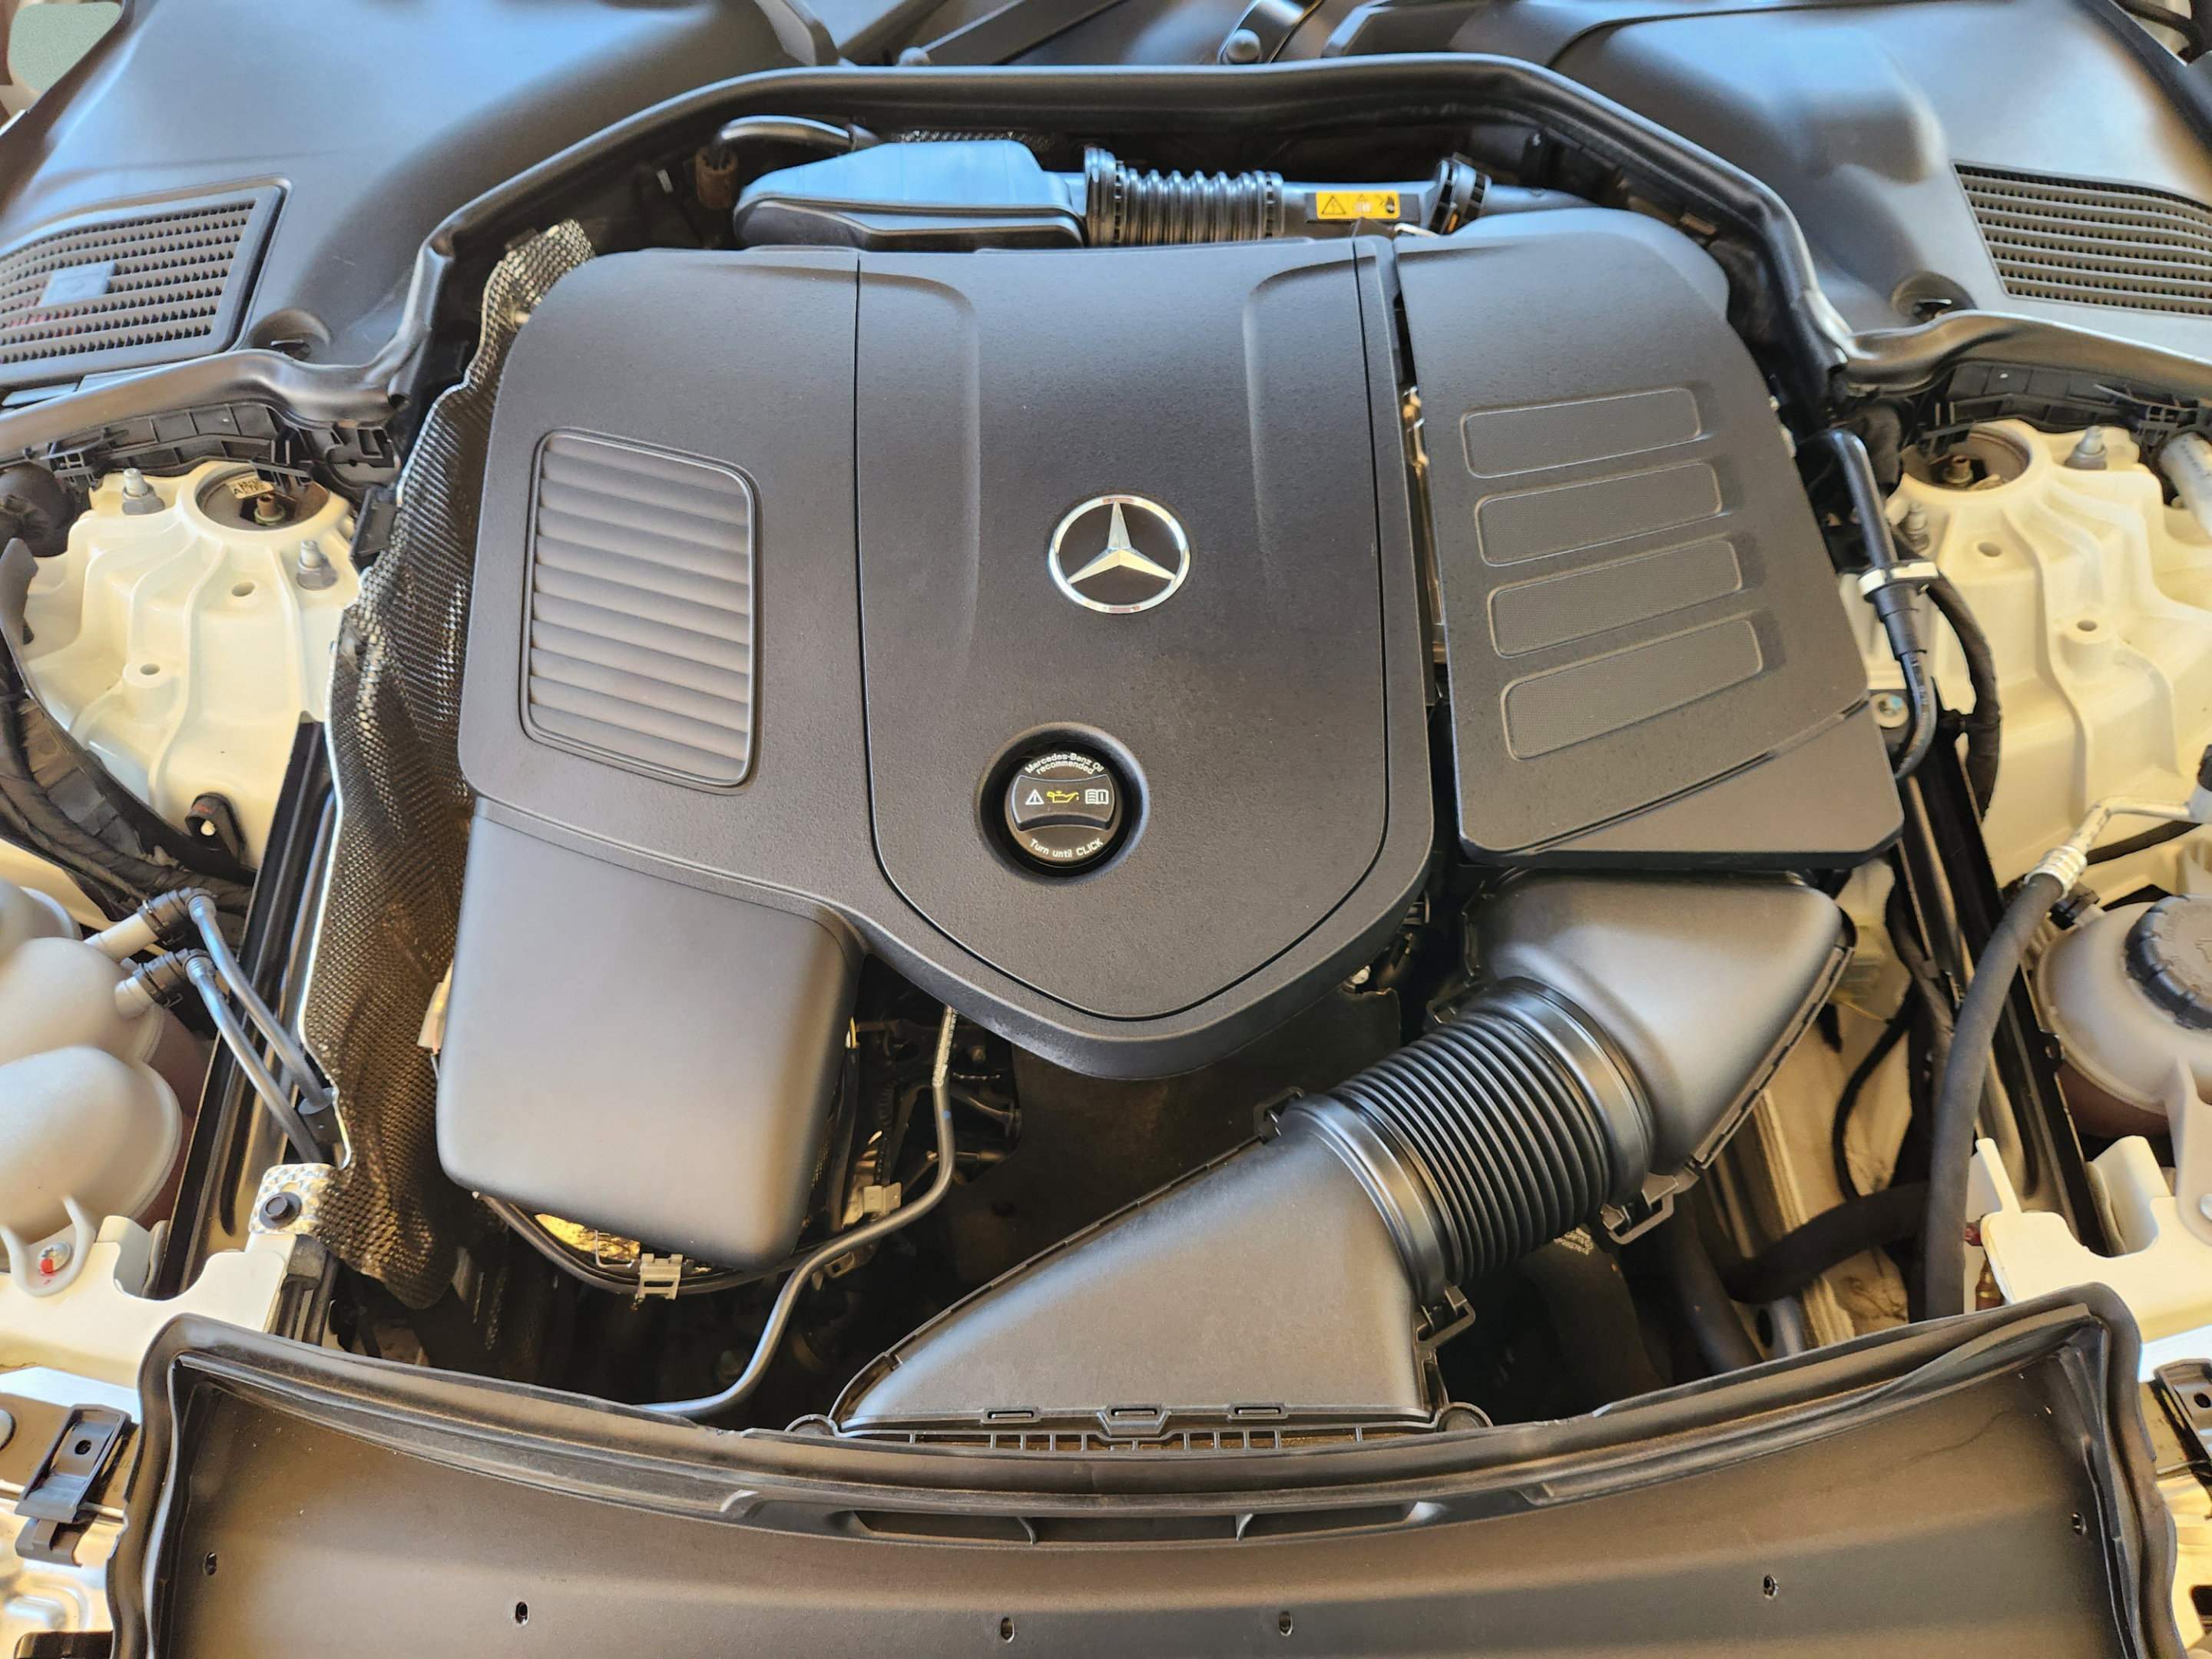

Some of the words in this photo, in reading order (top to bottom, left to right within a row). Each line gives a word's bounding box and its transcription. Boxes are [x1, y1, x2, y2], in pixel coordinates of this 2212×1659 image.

[1025, 753, 1091, 773] Mercedes-Benz
[1092, 761, 1104, 772] Oil
[1036, 760, 1094, 775] recommended
[1030, 839, 1049, 854] Turn
[1052, 849, 1072, 858] until
[1076, 838, 1103, 856] CLICK
